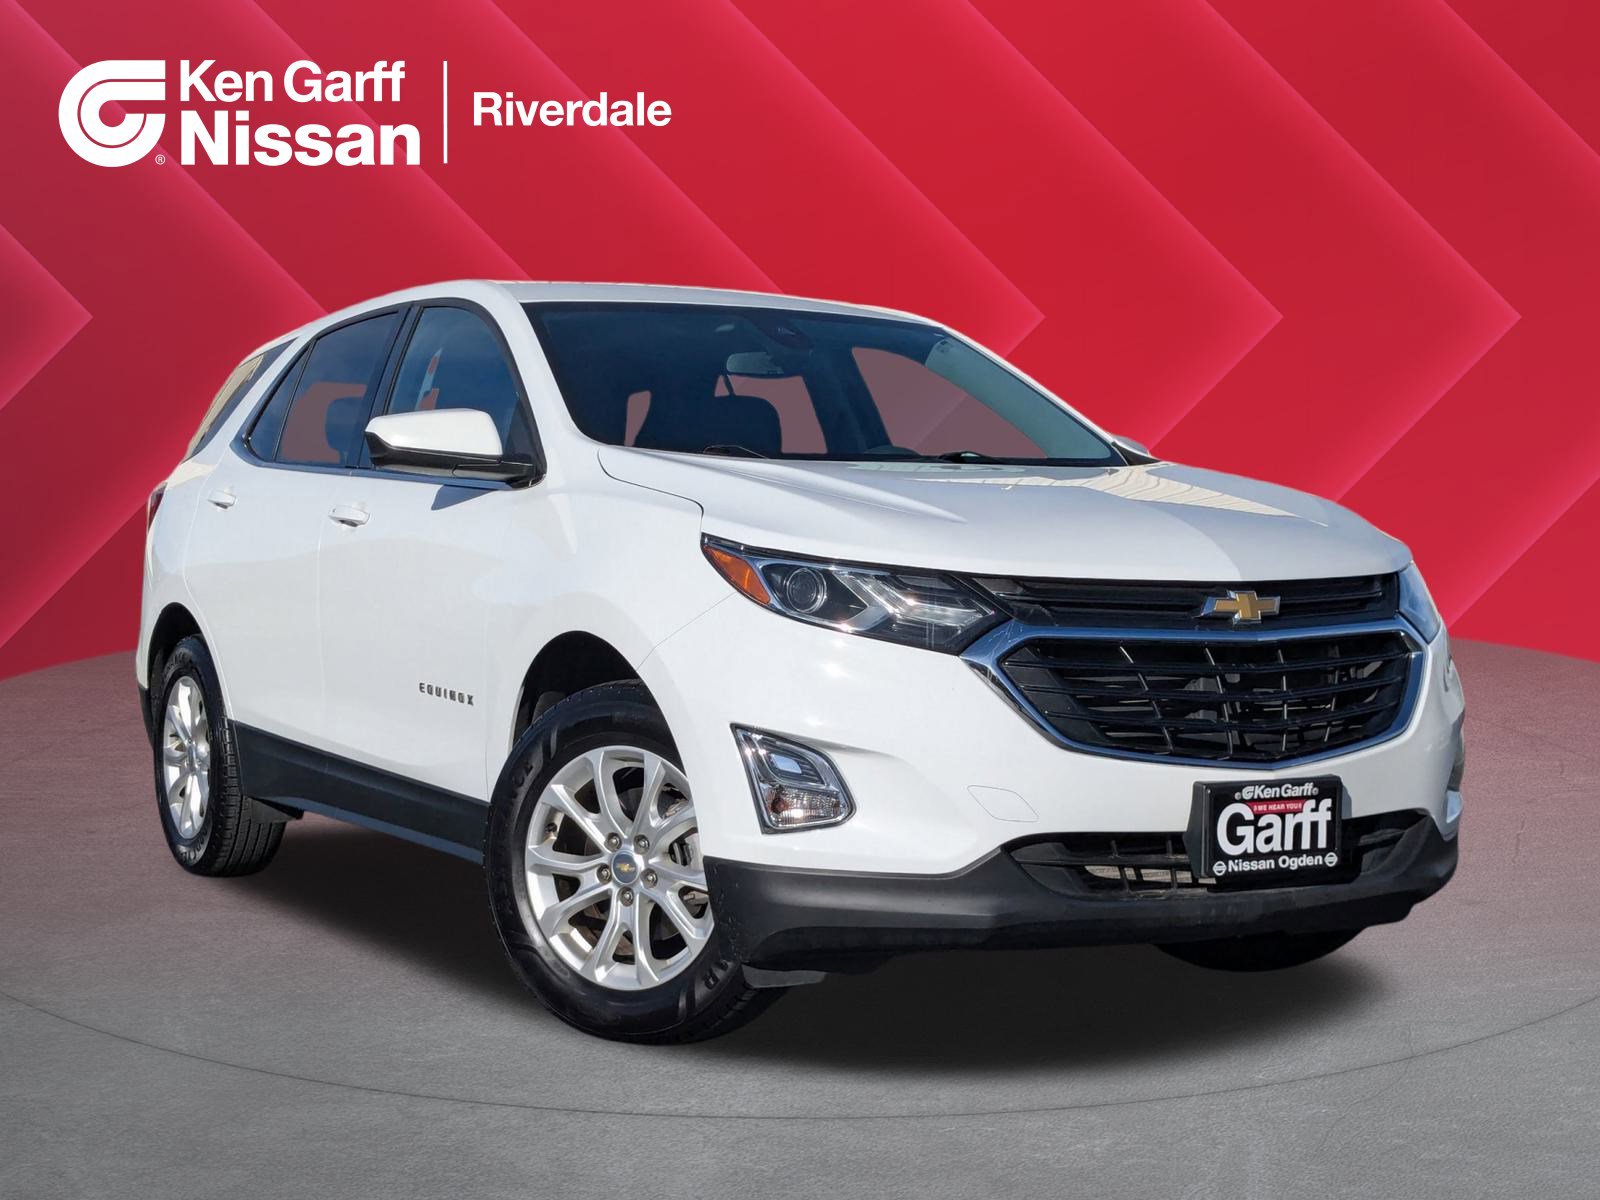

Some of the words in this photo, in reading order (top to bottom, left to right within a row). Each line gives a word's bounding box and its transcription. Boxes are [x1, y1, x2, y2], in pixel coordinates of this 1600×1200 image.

[419, 682, 474, 706] EQUINOX
[1253, 785, 1279, 799] Ken
[1280, 782, 1314, 798] Garff
[1268, 803, 1285, 811] HEAR
[1216, 798, 1332, 856] Garff
[1228, 859, 1275, 872] Nissan
[1278, 854, 1323, 870] Ogden
